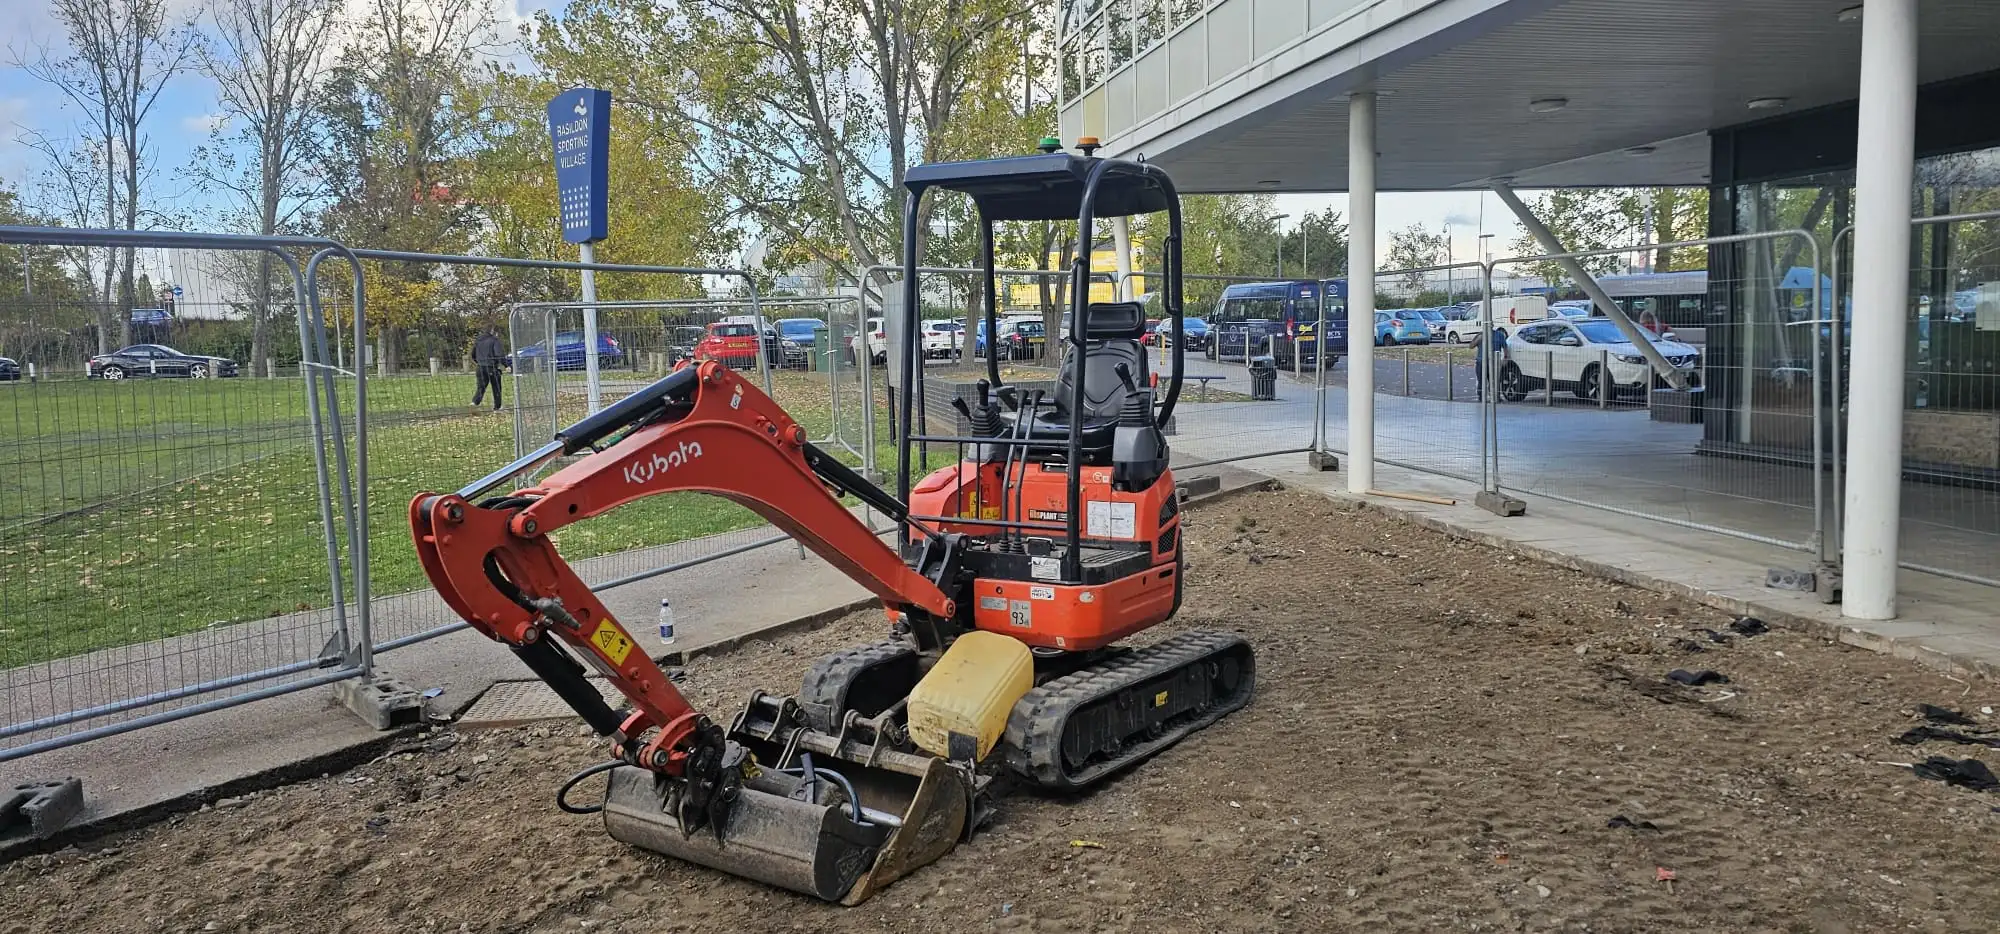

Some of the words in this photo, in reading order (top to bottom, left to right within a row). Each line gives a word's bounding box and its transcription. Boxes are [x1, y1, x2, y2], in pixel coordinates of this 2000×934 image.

[556, 117, 589, 137] BASILDON
[557, 134, 589, 154] SPORTING
[560, 152, 587, 169] VILLAGE
[624, 441, 702, 483] Kubota
[1012, 611, 1024, 625] 93
